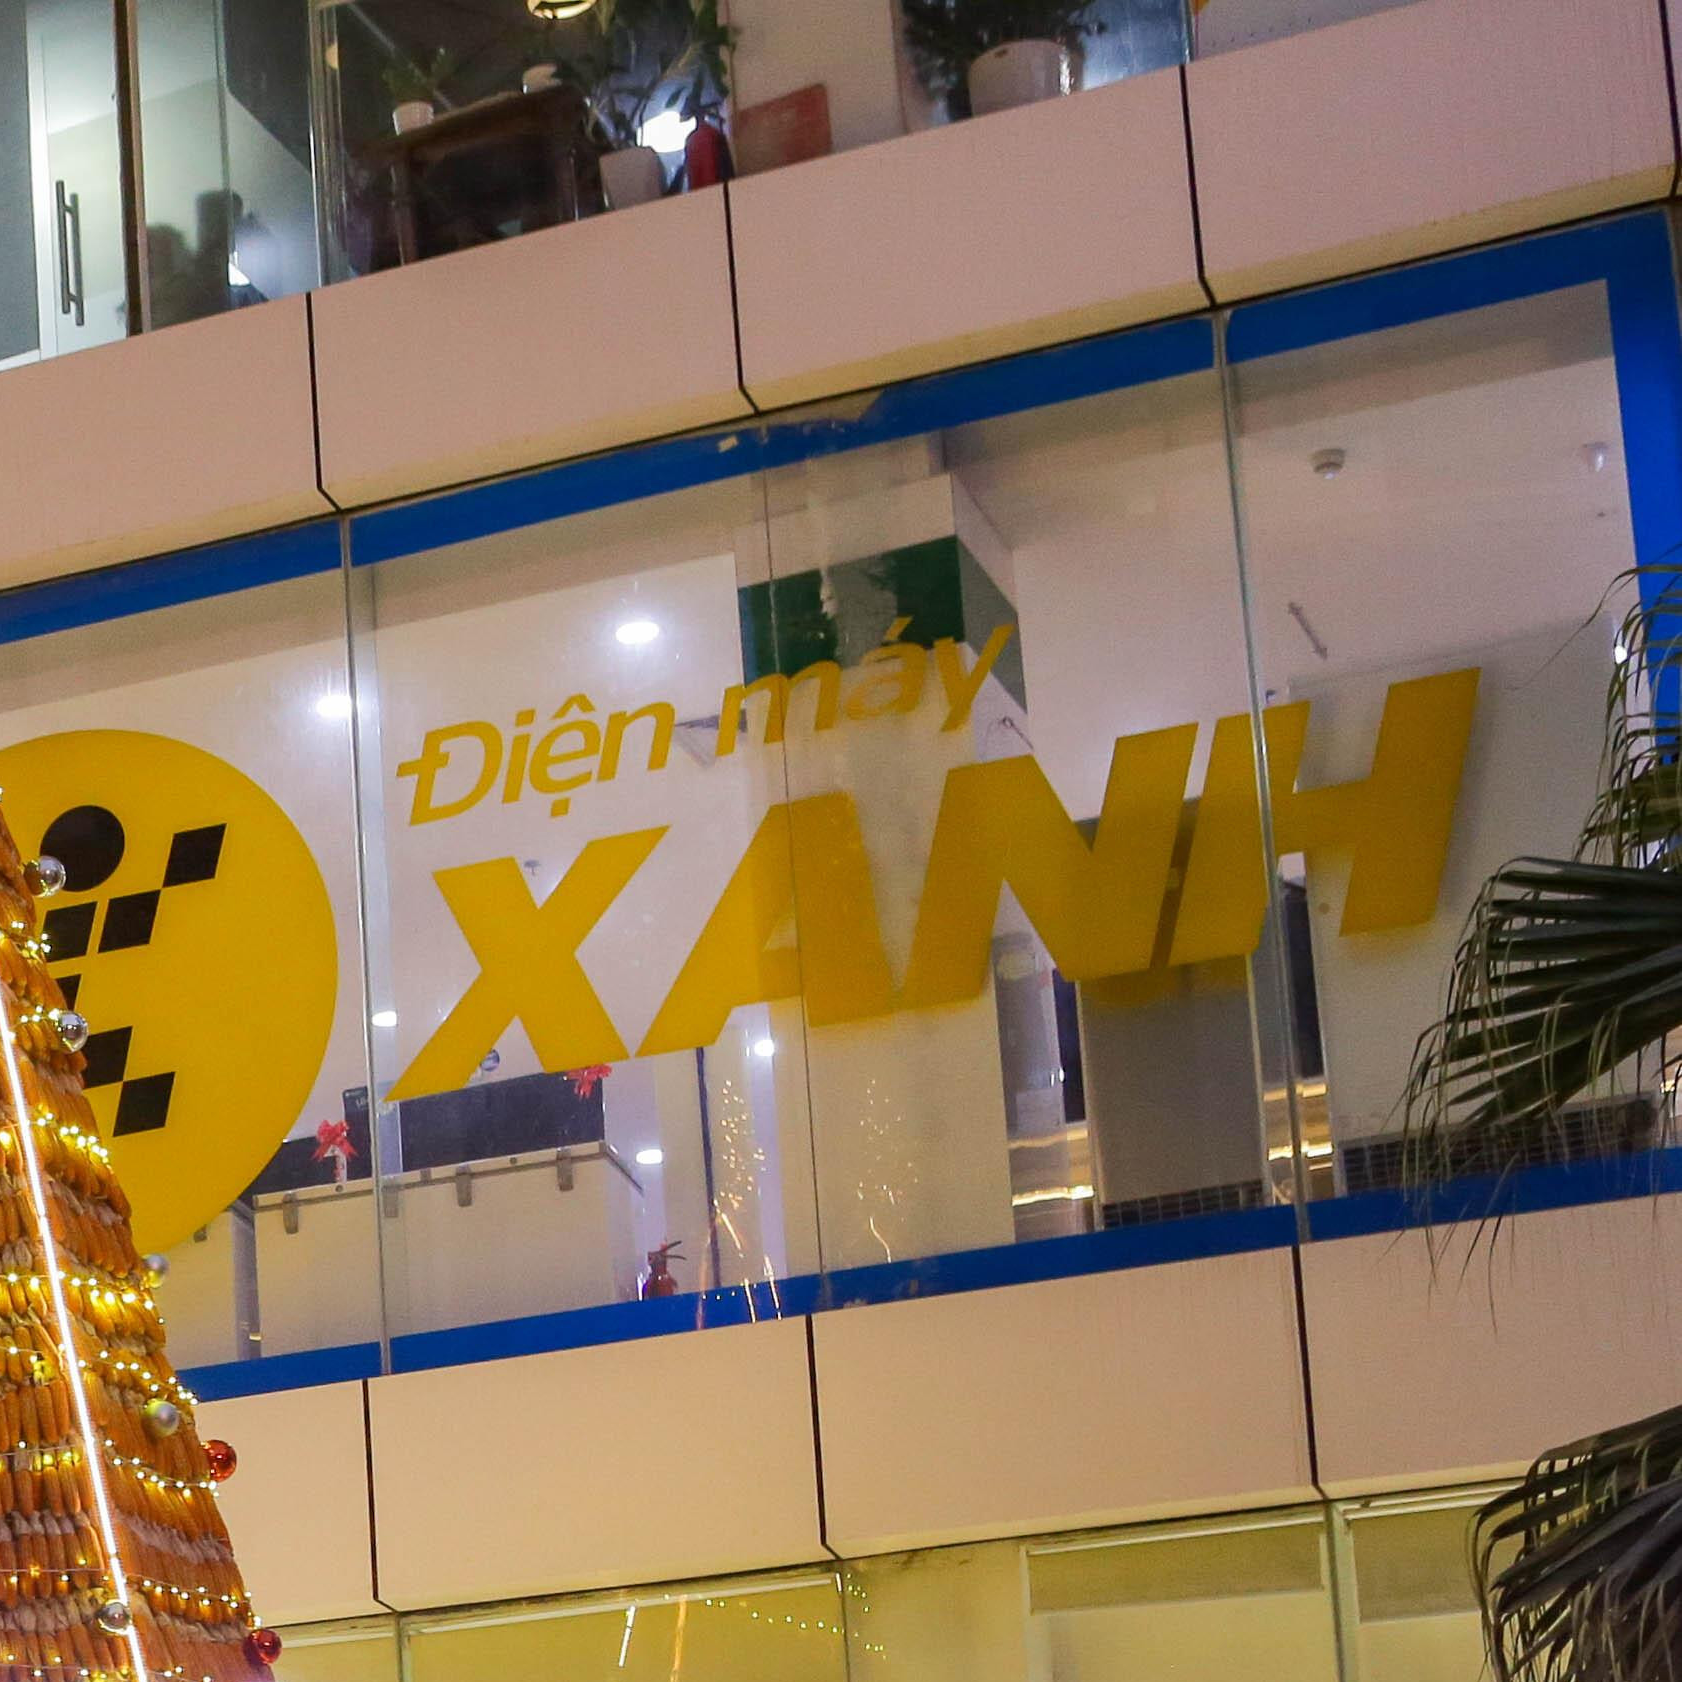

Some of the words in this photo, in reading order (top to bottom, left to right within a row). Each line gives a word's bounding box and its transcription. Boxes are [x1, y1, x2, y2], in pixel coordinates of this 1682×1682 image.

[395, 688, 677, 827] Điện
[718, 612, 1018, 758] máy
[383, 666, 1482, 1104] XANH
